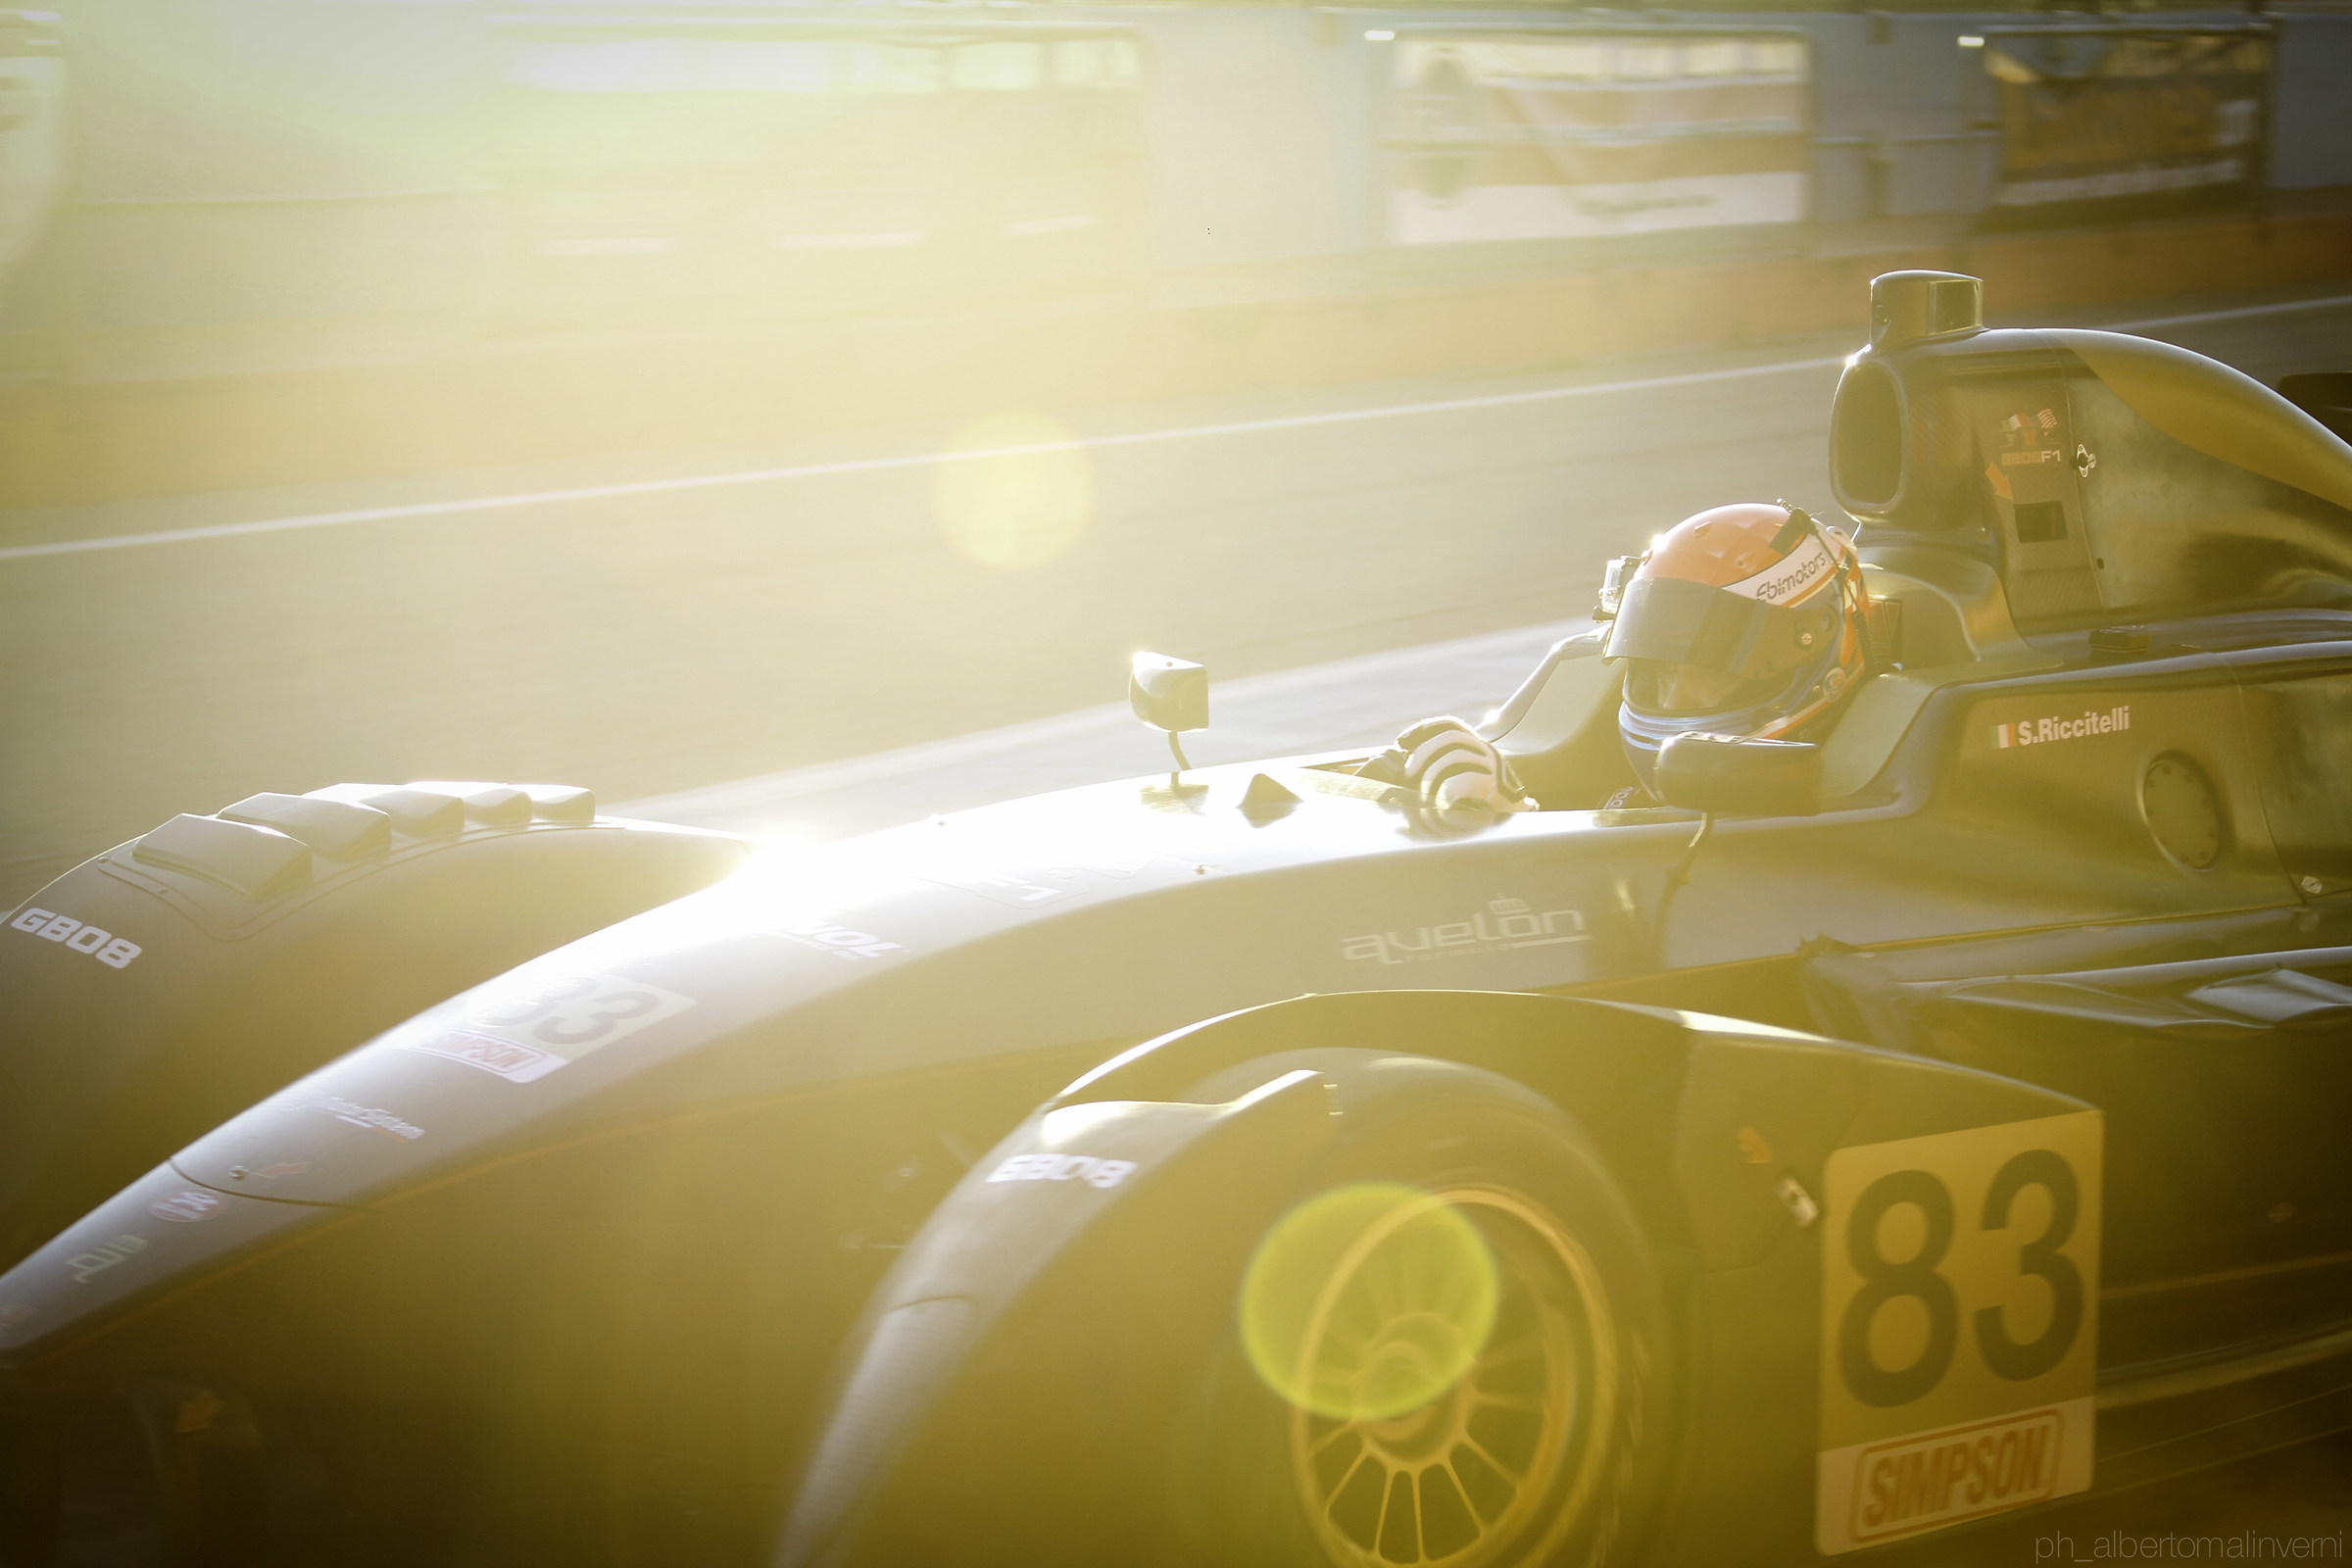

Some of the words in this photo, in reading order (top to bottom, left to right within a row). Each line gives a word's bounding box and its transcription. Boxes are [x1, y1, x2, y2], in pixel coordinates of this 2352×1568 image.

[2018, 705, 2130, 746] S.Riccitelli
[10, 906, 143, 969] GB08
[1838, 1149, 2084, 1408] 83
[1865, 1422, 2051, 1529] SIMPSON
